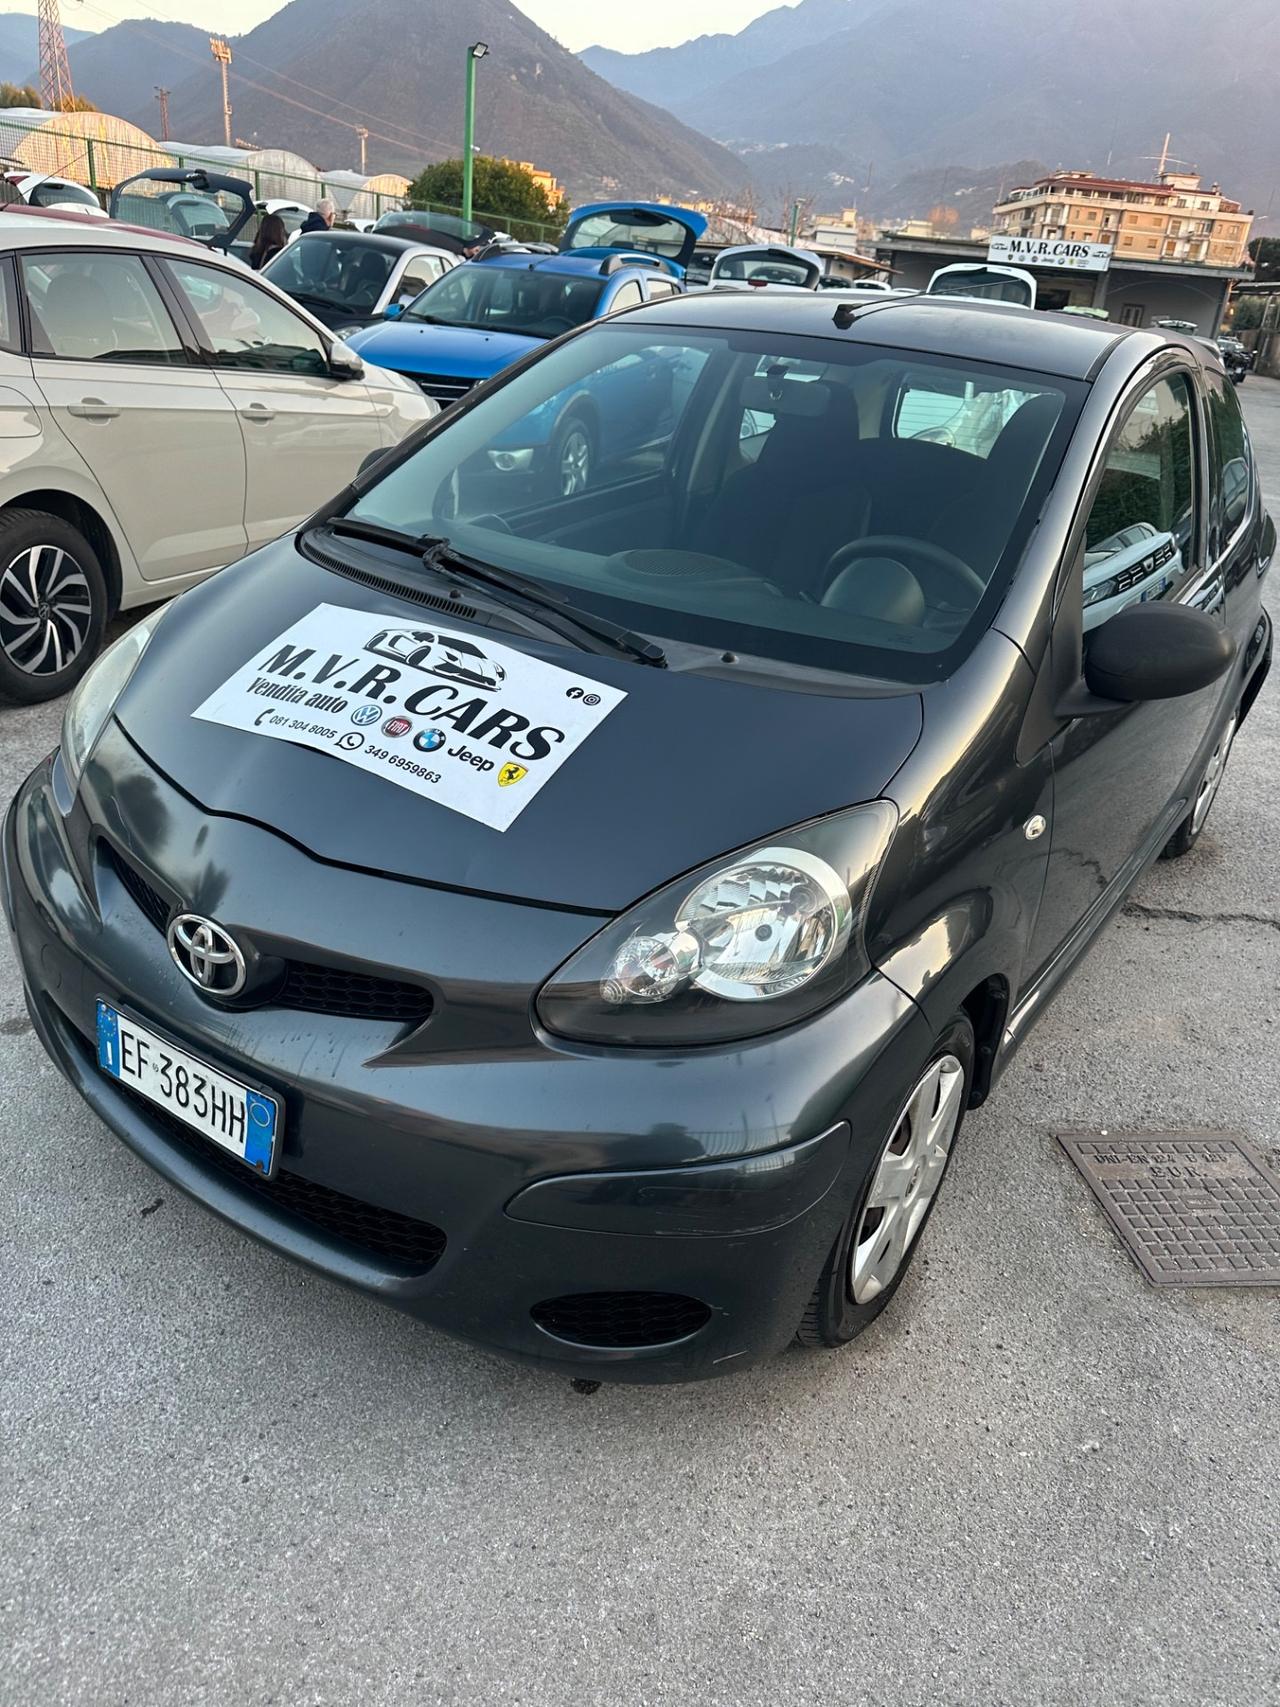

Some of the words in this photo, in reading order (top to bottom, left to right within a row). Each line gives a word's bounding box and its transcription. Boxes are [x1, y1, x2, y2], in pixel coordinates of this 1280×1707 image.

[1009, 240, 1091, 258] M.V.R.CARS
[246, 677, 308, 704] Vendita
[304, 693, 348, 714] auto
[257, 644, 566, 761] M.V.R.CARS
[269, 715, 290, 726] 081
[288, 719, 310, 731] 304
[308, 724, 338, 739] 8005
[364, 744, 389, 760] 349
[388, 754, 442, 784] 6959863
[447, 745, 495, 772] Jeep
